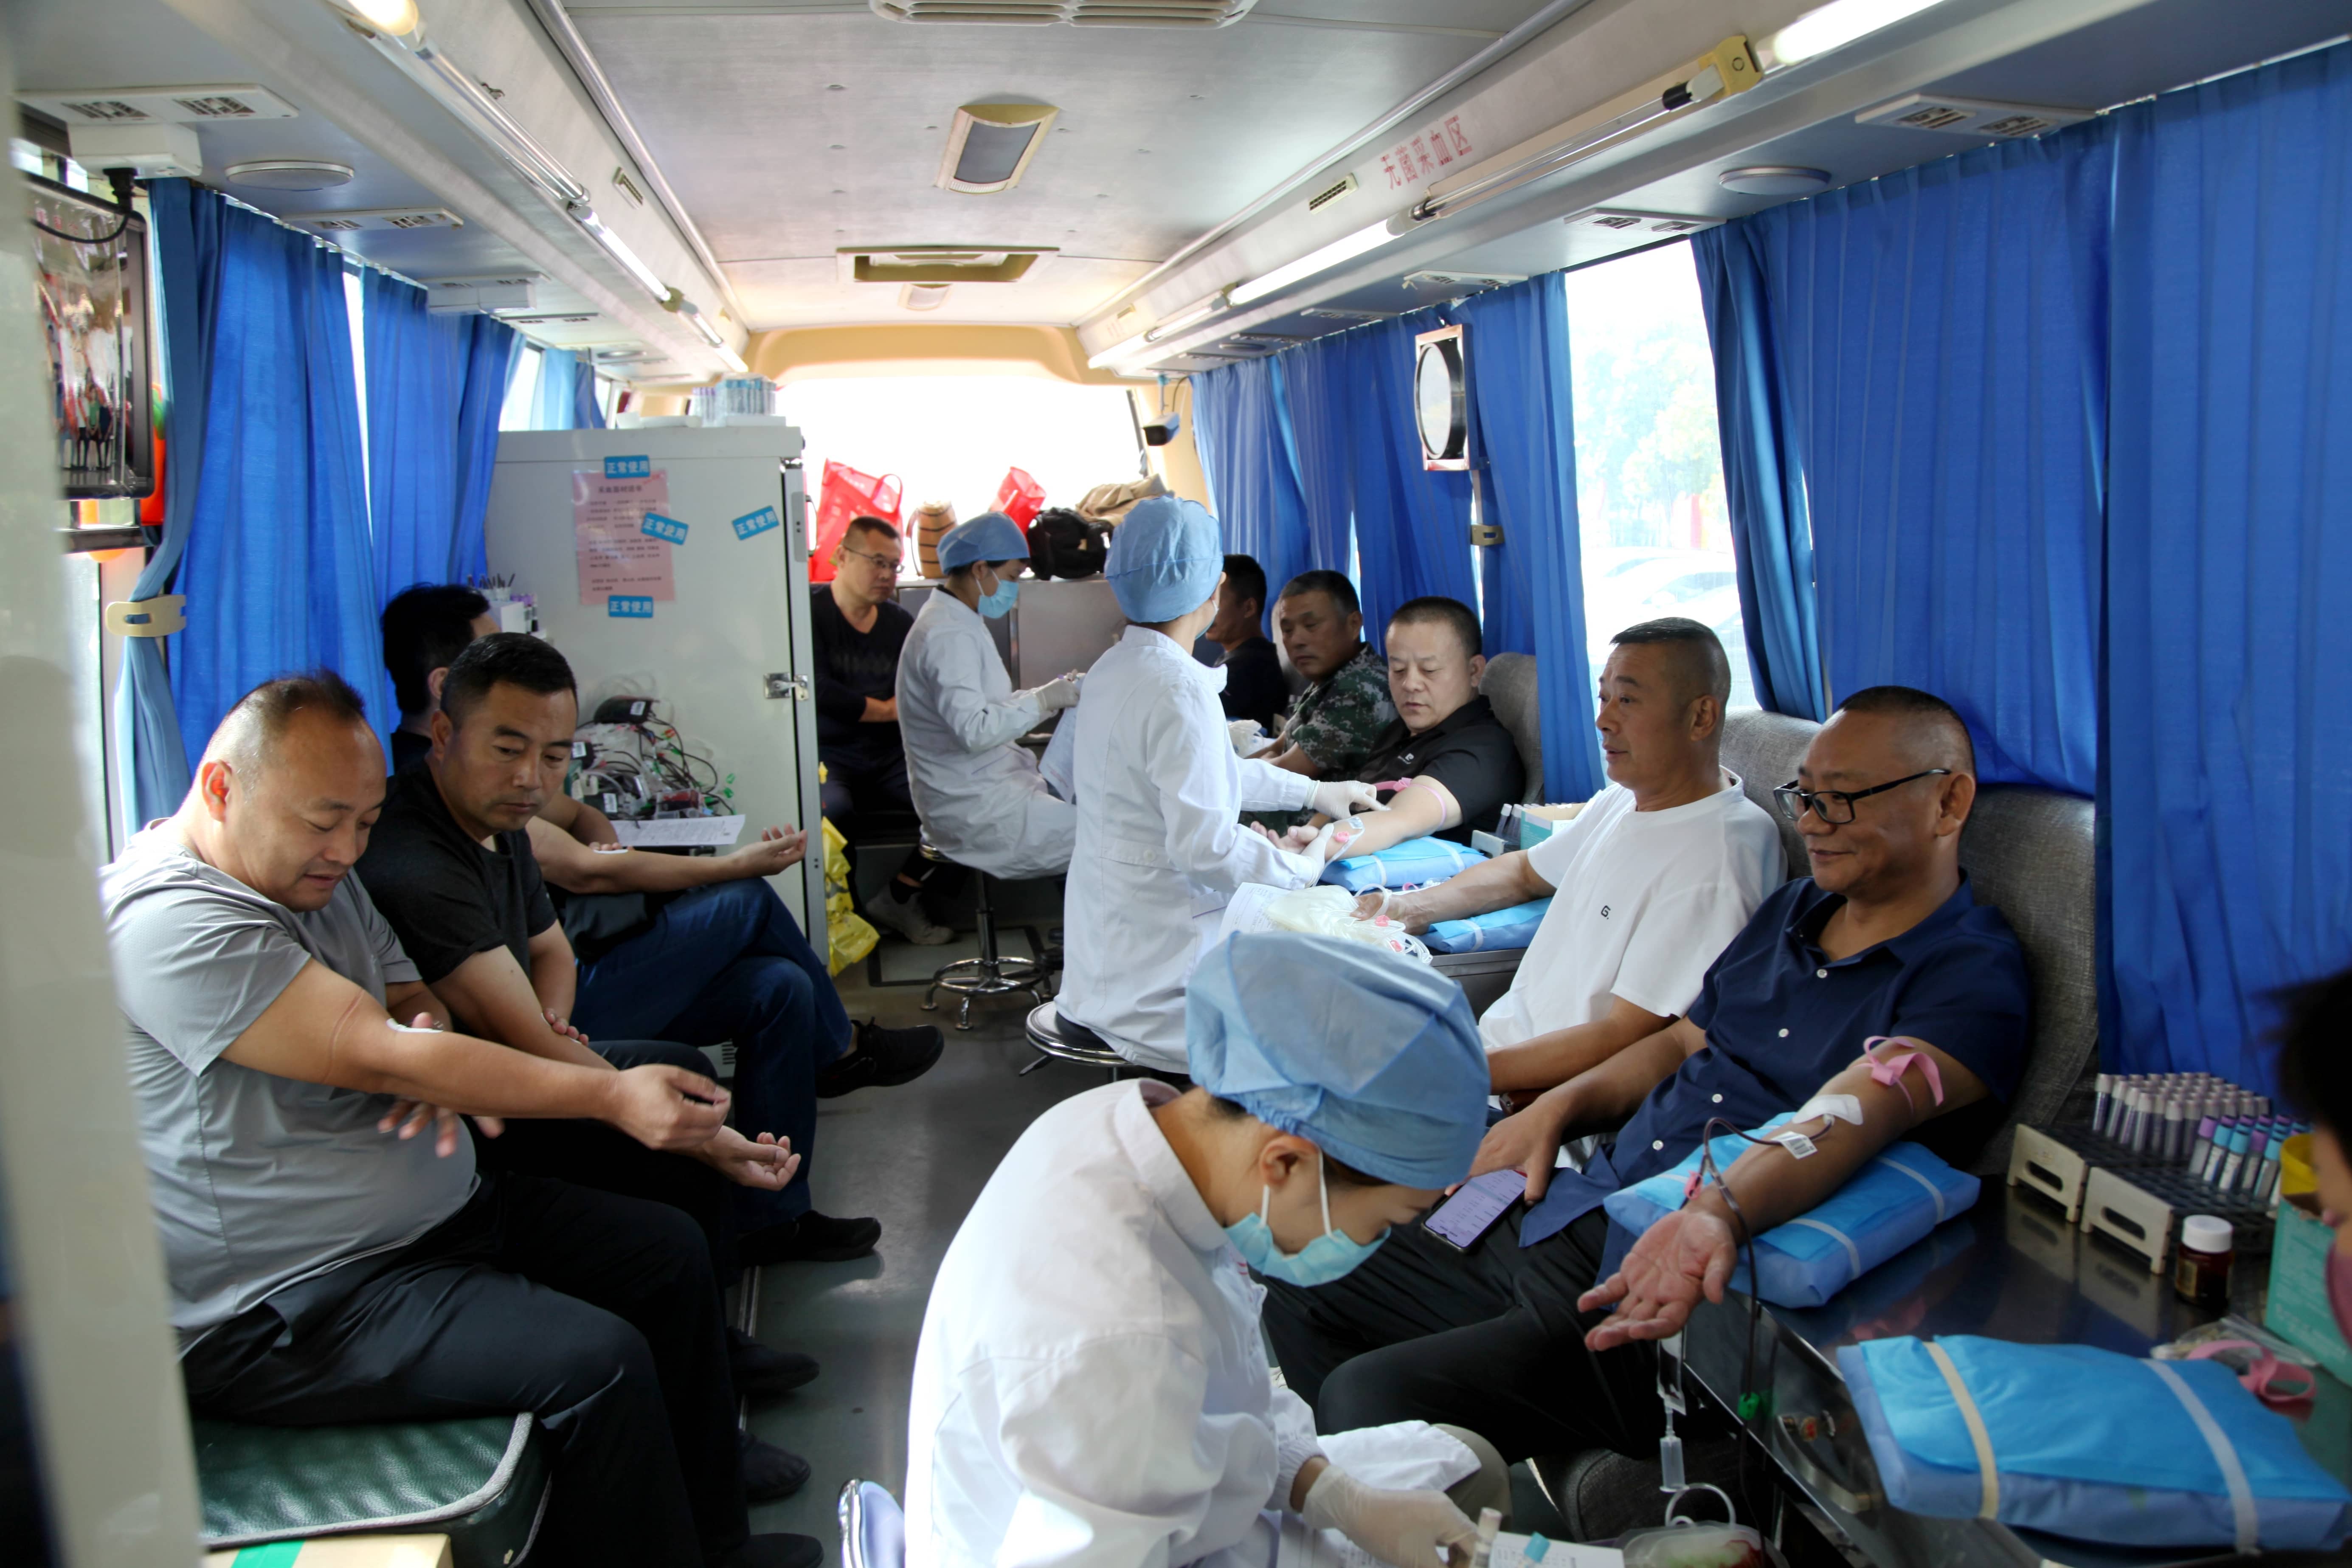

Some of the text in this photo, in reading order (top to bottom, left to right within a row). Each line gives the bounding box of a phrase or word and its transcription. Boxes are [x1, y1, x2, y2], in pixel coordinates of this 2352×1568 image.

[1380, 115, 1473, 190] 无菌采血区
[607, 460, 649, 474] 正常使用
[643, 518, 686, 540] 正常使用
[736, 510, 777, 535] 正常使用
[610, 600, 652, 613] 正常使用
